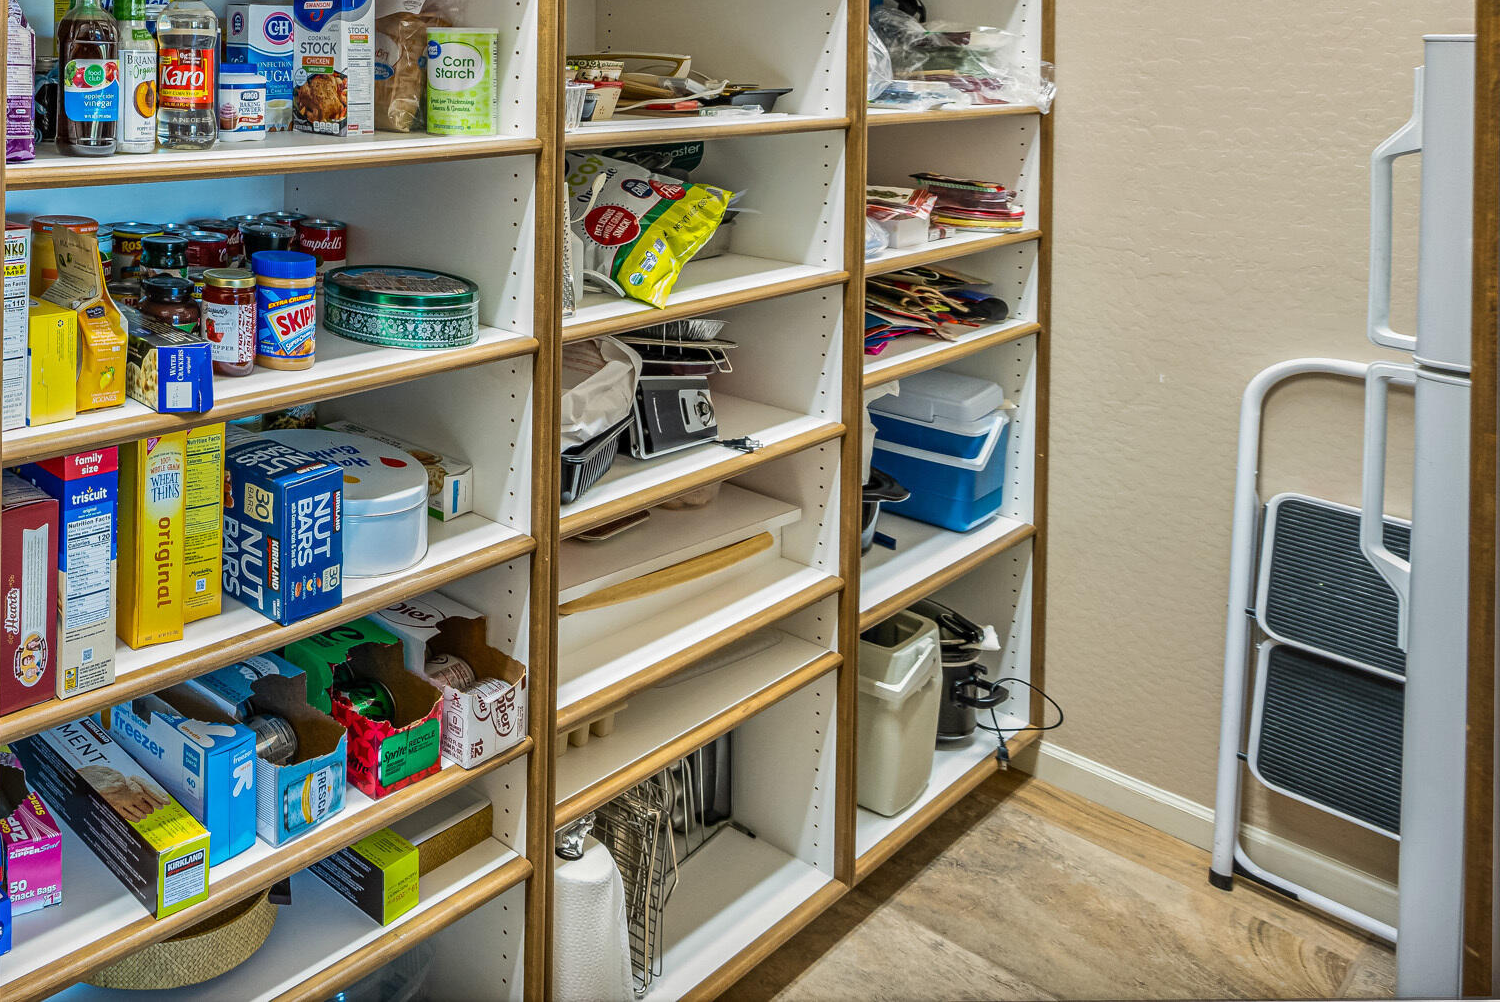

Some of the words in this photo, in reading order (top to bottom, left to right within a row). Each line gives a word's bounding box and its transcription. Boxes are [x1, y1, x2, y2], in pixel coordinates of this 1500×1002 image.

[300, 42, 337, 55] STOCK
[306, 57, 331, 65] CHICKEN
[442, 56, 475, 67] Corn
[161, 66, 205, 86] Karo
[435, 67, 475, 79] Starch
[84, 99, 112, 109] vinegar
[594, 208, 616, 237] DELICIOUS
[613, 218, 632, 238] SNACK!
[12, 299, 26, 307] 110
[268, 299, 288, 309] EXTRA
[74, 453, 103, 466] family
[81, 465, 99, 475] size
[150, 472, 181, 488] WHEAT
[71, 487, 108, 506] triscuit
[255, 488, 271, 523] 30
[67, 518, 94, 529] Nutrition
[94, 514, 111, 523] Facts
[314, 491, 331, 558] NUT
[67, 539, 91, 549] Calories
[97, 533, 111, 542] 120
[297, 497, 313, 567] BARS
[154, 516, 174, 609] original
[222, 515, 240, 596] BARS
[271, 539, 280, 591] KIRKLAND
[240, 523, 264, 610] NUT
[329, 566, 339, 588] 30
[503, 687, 516, 711] Dr
[84, 719, 110, 744] KIRKLAND
[113, 711, 165, 760] freezer
[409, 730, 436, 748] RECYCLE
[233, 749, 253, 764] freezer
[383, 746, 407, 764] Sprite
[408, 746, 418, 755] ME
[474, 738, 484, 758] 12
[186, 776, 196, 789] 40
[316, 770, 328, 816] FRESCA
[167, 851, 204, 873] KIRKLAND
[9, 879, 28, 894] 50
[10, 889, 35, 903] Snack
[37, 883, 57, 897] Bags
